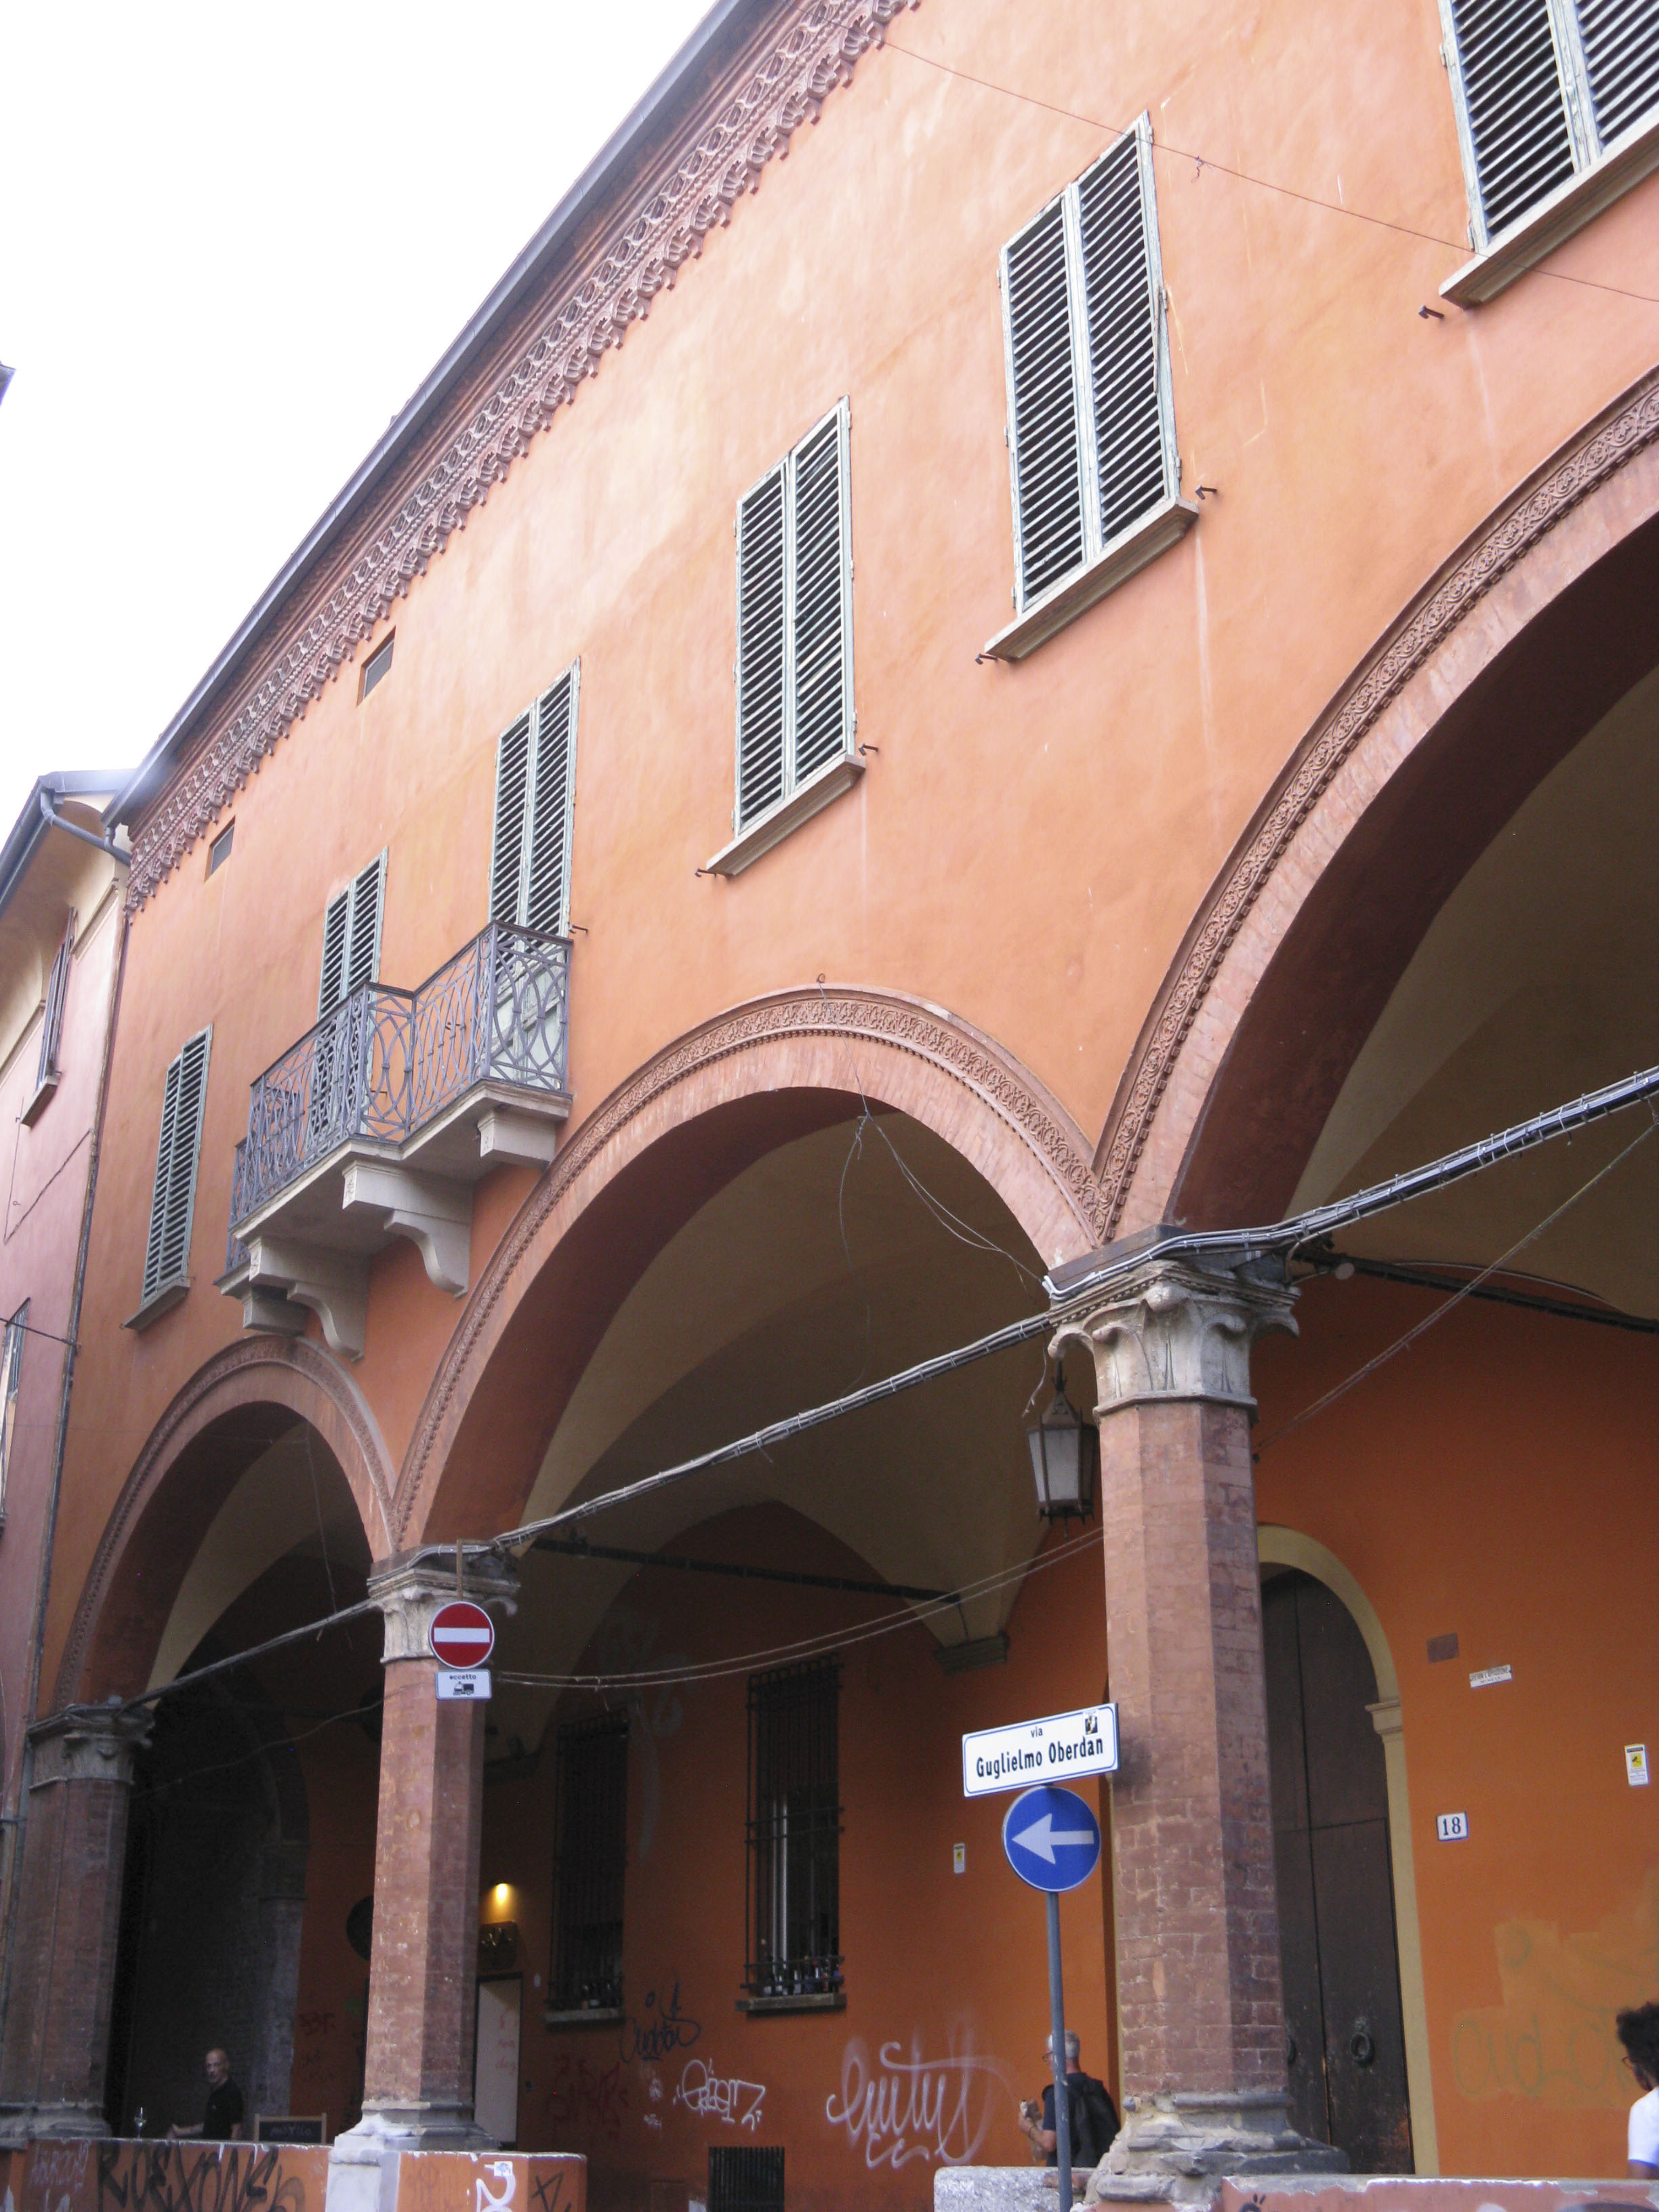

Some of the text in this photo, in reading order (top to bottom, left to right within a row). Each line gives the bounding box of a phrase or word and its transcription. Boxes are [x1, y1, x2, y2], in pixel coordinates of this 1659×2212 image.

[1030, 1727, 1043, 1738] via
[976, 1736, 1104, 1780] Guglielmo Oberdan
[1441, 1816, 1462, 1837] 18
